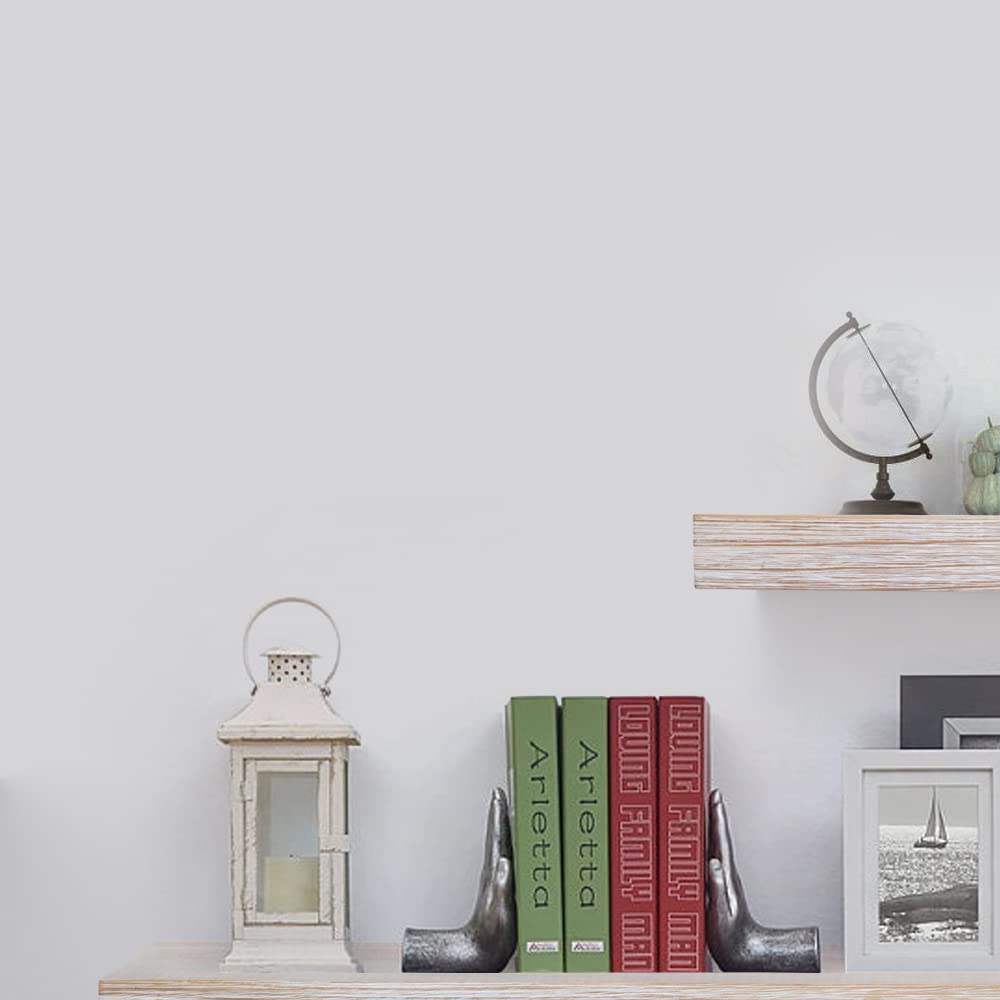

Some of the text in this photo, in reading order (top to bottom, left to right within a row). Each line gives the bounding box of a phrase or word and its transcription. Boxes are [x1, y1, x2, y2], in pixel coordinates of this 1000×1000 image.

[618, 703, 654, 972] LOVING FAMILY MAN
[667, 703, 702, 972] LOVING FAMILY MAN
